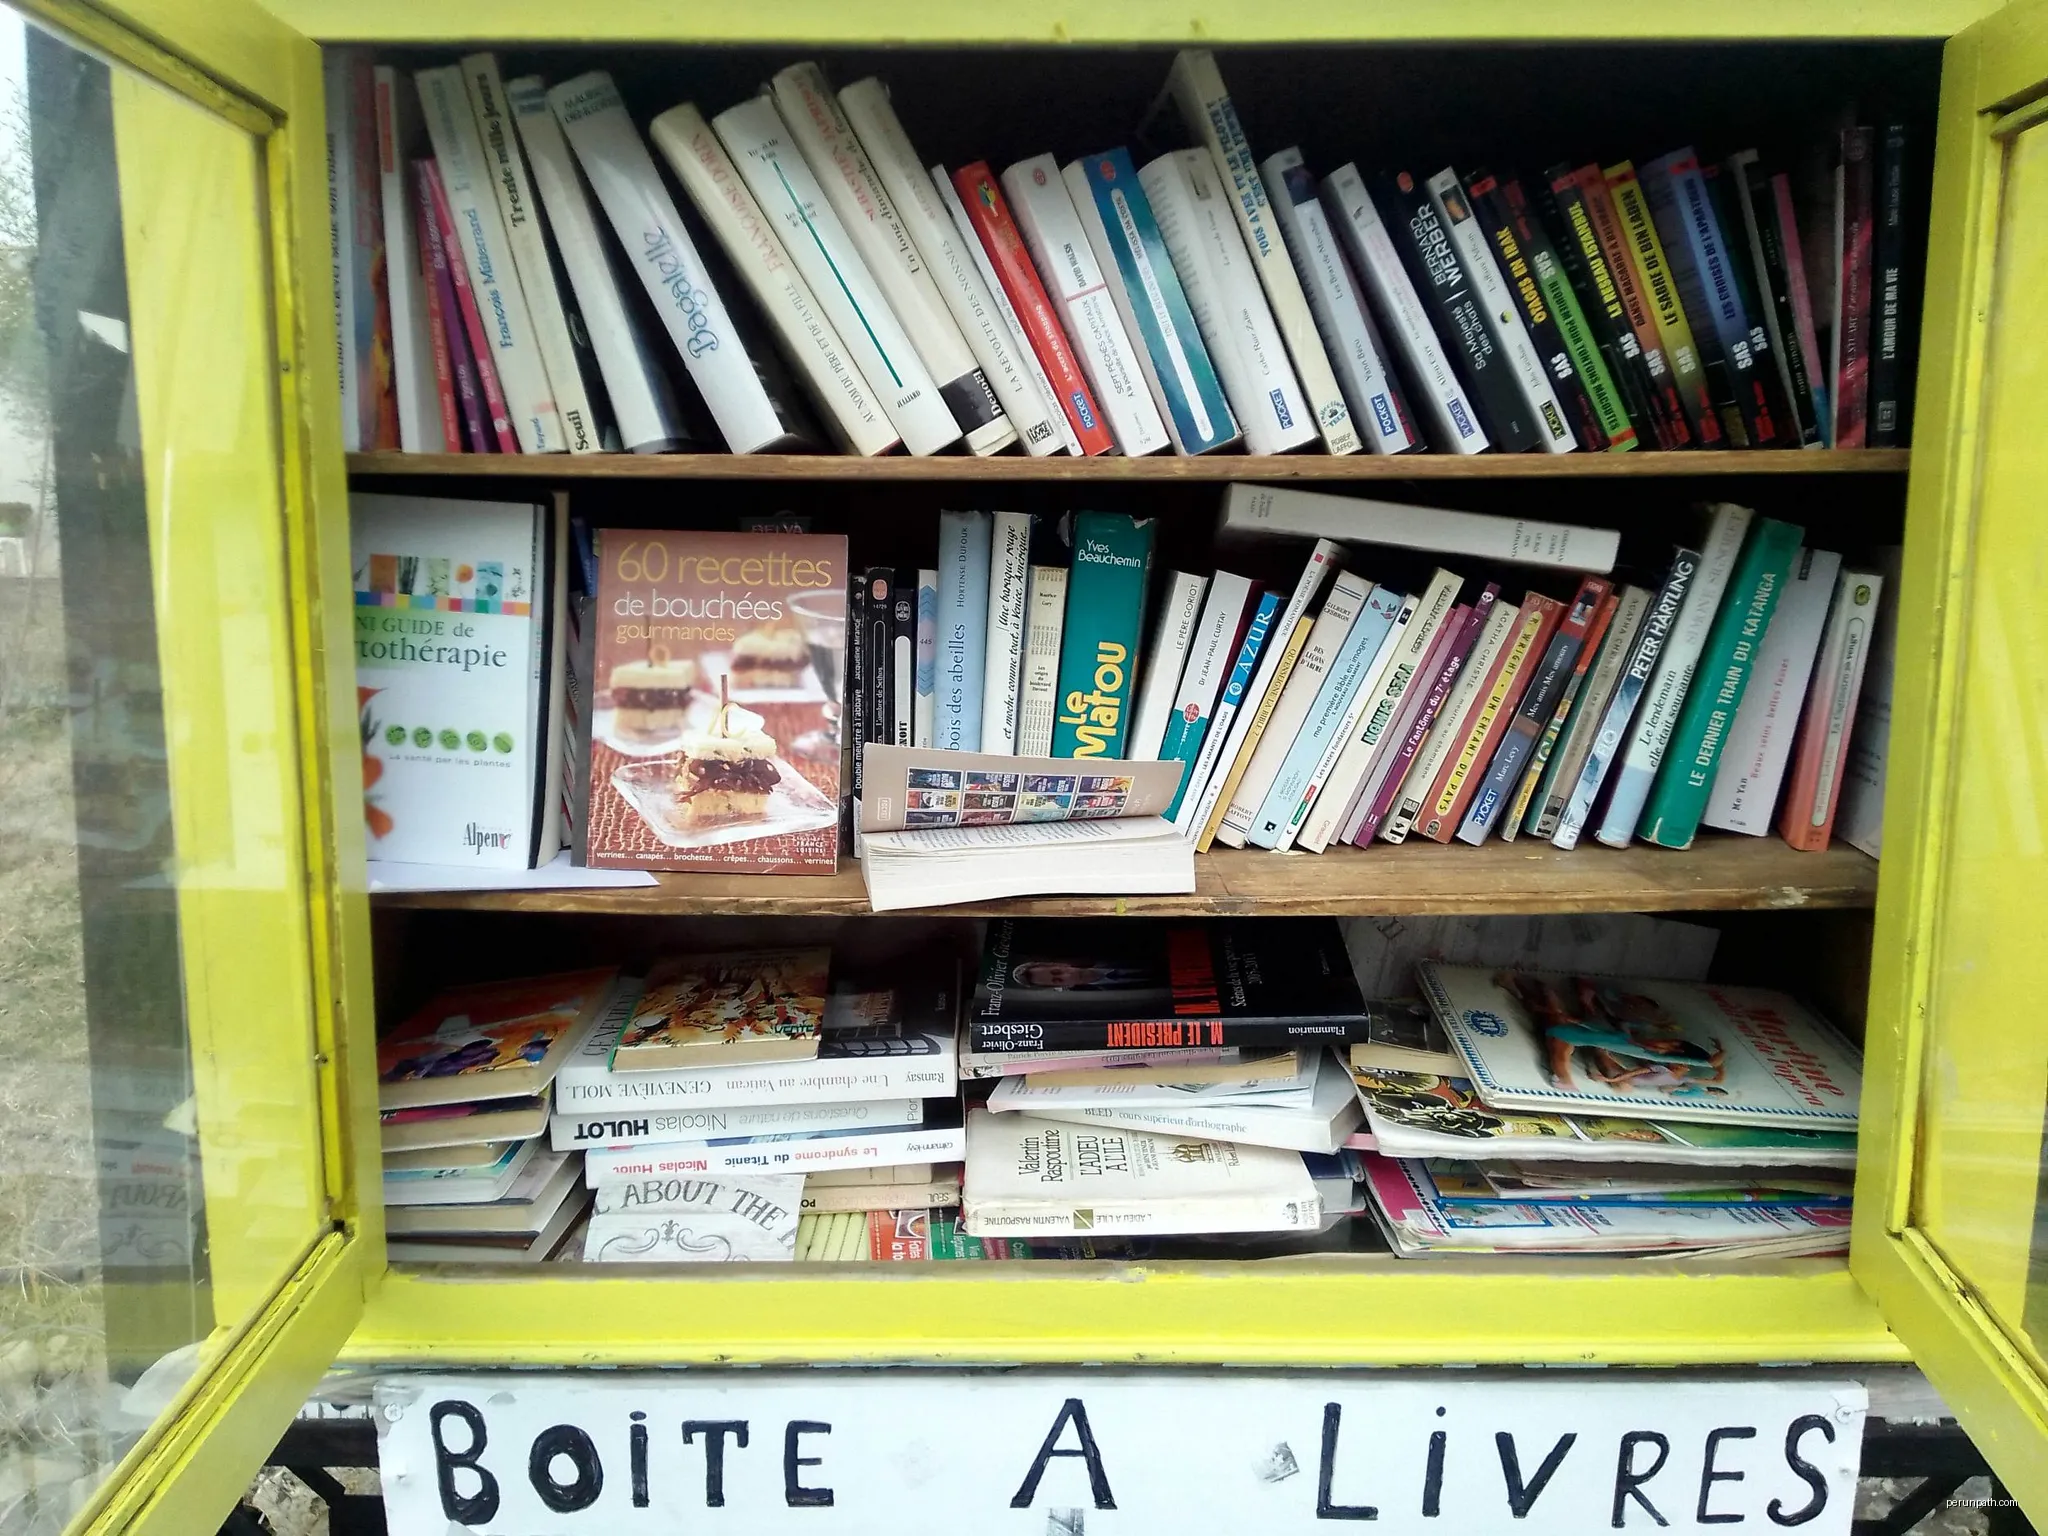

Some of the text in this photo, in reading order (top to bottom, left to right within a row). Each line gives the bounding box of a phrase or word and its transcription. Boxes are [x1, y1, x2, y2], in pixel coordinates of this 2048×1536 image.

[472, 72, 527, 227] Trente mille jours
[462, 207, 495, 285] Mitterrand
[1063, 242, 1079, 266] WALSH
[1408, 215, 1447, 285] BERNARD
[1416, 202, 1465, 287] WERBER
[1564, 200, 1624, 318] LE RESEAU ISTANBUL
[1619, 188, 1678, 326] LE SABRE DE BIN LADEN
[938, 239, 972, 292] NONNES
[1493, 225, 1549, 324] OTAGES EN IRAK
[1531, 250, 1557, 280] SAS
[642, 226, 719, 359] Bagatelle
[965, 292, 985, 317] DES
[485, 287, 513, 349] François
[1081, 299, 1102, 339] CAPITAUX
[1460, 299, 1494, 355] des chats
[1882, 267, 1898, 359] L'AMOUR DE MA VIE
[1616, 331, 1642, 359] SAS
[1730, 339, 1754, 369] SAS
[1747, 325, 1769, 351] SAS
[1423, 344, 1448, 387] Allen Carr
[1549, 350, 1573, 379] SAS
[1643, 347, 1666, 376] SAS
[1008, 374, 1023, 392] LA
[1110, 372, 1124, 394] SEPT
[1270, 388, 1293, 428] POCKET
[1448, 399, 1473, 437] POCKET
[566, 409, 588, 450] Seuil
[1078, 548, 1141, 568] Beauchemin
[1086, 539, 1110, 554] Yves
[617, 541, 832, 587] 60 recettes
[997, 524, 1019, 625] Une baraque rouge
[614, 588, 783, 620] de bouchées
[1175, 583, 1198, 650] LE PÈRE GORIOT
[1326, 601, 1352, 616] GILBERT
[1630, 557, 1694, 680] PETER HÄRTLING
[382, 617, 444, 636] GUIDE
[452, 622, 475, 638] de
[616, 622, 735, 644] gourmandes
[853, 618, 861, 644] Mirande
[919, 637, 933, 646] 445
[1200, 638, 1217, 677] JEAN-PAUL
[1213, 610, 1226, 638] CURTAY
[1236, 605, 1273, 674] AZUR
[852, 646, 861, 680] Jacqueline
[946, 622, 966, 681] abeilles
[1504, 631, 1530, 676] WRIGHT
[1687, 569, 1777, 788] LE DERNIER TRAIN DU KATANGA
[852, 688, 864, 720] l'abbaye
[945, 687, 962, 713] des
[1059, 690, 1085, 725] Le
[1073, 640, 1128, 759] Matou
[1360, 659, 1415, 747] YVES SIMON
[1487, 694, 1500, 710] UN
[1638, 667, 1676, 745] Le lendemain
[854, 728, 862, 760] meurtre
[943, 718, 961, 750] bois
[1465, 715, 1490, 758] ENFANT
[853, 761, 863, 788] Double
[1454, 762, 1467, 778] DU
[1496, 745, 1523, 783] Marc Levy
[1438, 782, 1457, 812] PAYS
[1472, 788, 1498, 826] POCKET
[674, 853, 721, 863] brochettes...
[757, 856, 802, 864] chaussons...
[981, 1023, 1042, 1039] Giesbert
[982, 1039, 1043, 1049] Franz-Olivier
[1106, 1020, 1223, 1047] M. LE PRESIDENT
[1288, 1025, 1345, 1036] Flammarion
[617, 1079, 712, 1098] GENEVIÈVE
[726, 1073, 888, 1095] Une chambre au Vatican
[904, 1067, 944, 1088] Ramsay
[572, 1110, 727, 1143] Nicolas HULOT
[738, 1100, 869, 1128] Questions de nature
[1118, 1110, 1141, 1120] cours
[658, 1158, 707, 1174] Nicolas
[724, 1145, 877, 1169] Le syndrome du Titanic
[1019, 1135, 1040, 1179] Valentin
[1041, 1127, 1065, 1184] Raspoutine
[1080, 1134, 1099, 1177] L'ADIEU
[620, 1179, 788, 1231] ABOUT THE
[984, 1215, 1069, 1225] VALENTIN RASPOUTINE
[1009, 1398, 1117, 1511] A
